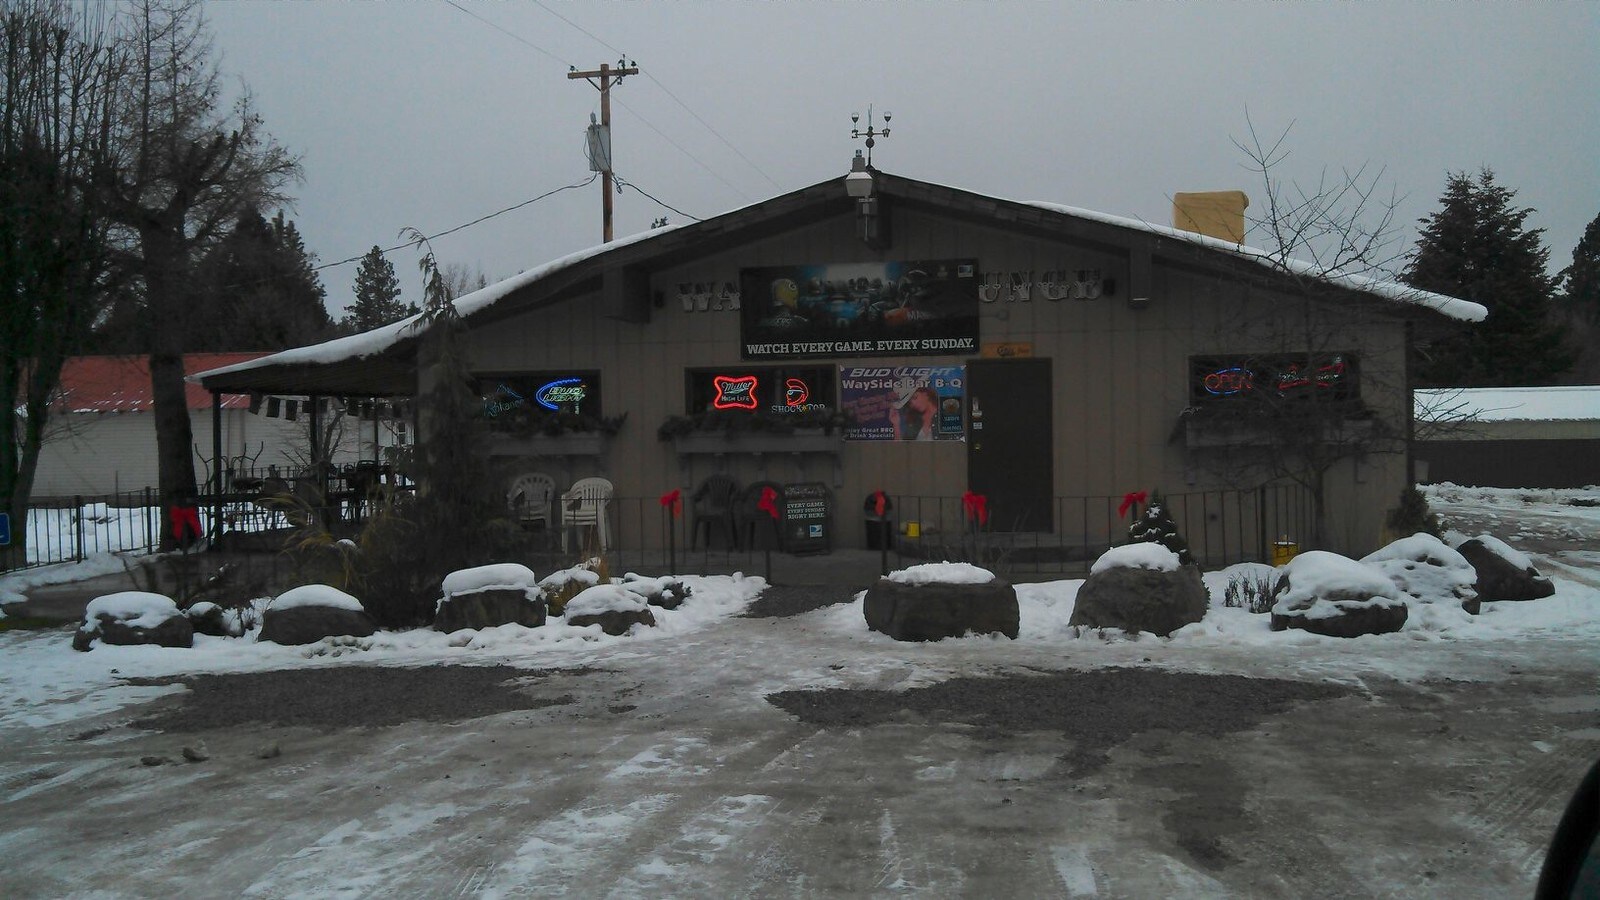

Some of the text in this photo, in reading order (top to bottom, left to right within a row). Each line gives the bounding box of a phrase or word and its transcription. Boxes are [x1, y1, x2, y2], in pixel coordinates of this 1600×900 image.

[747, 337, 974, 355] WATCH EVERY GAME. EVERY SUNDAY.
[850, 367, 955, 377] BUD LIGHT
[721, 381, 752, 393] Miller
[842, 378, 962, 391] WaySide Bar B-Q
[1204, 373, 1253, 392] OPEN
[548, 386, 583, 395] BUD
[542, 394, 582, 402] LIGHT
[771, 404, 825, 413] SHOCK TOP
